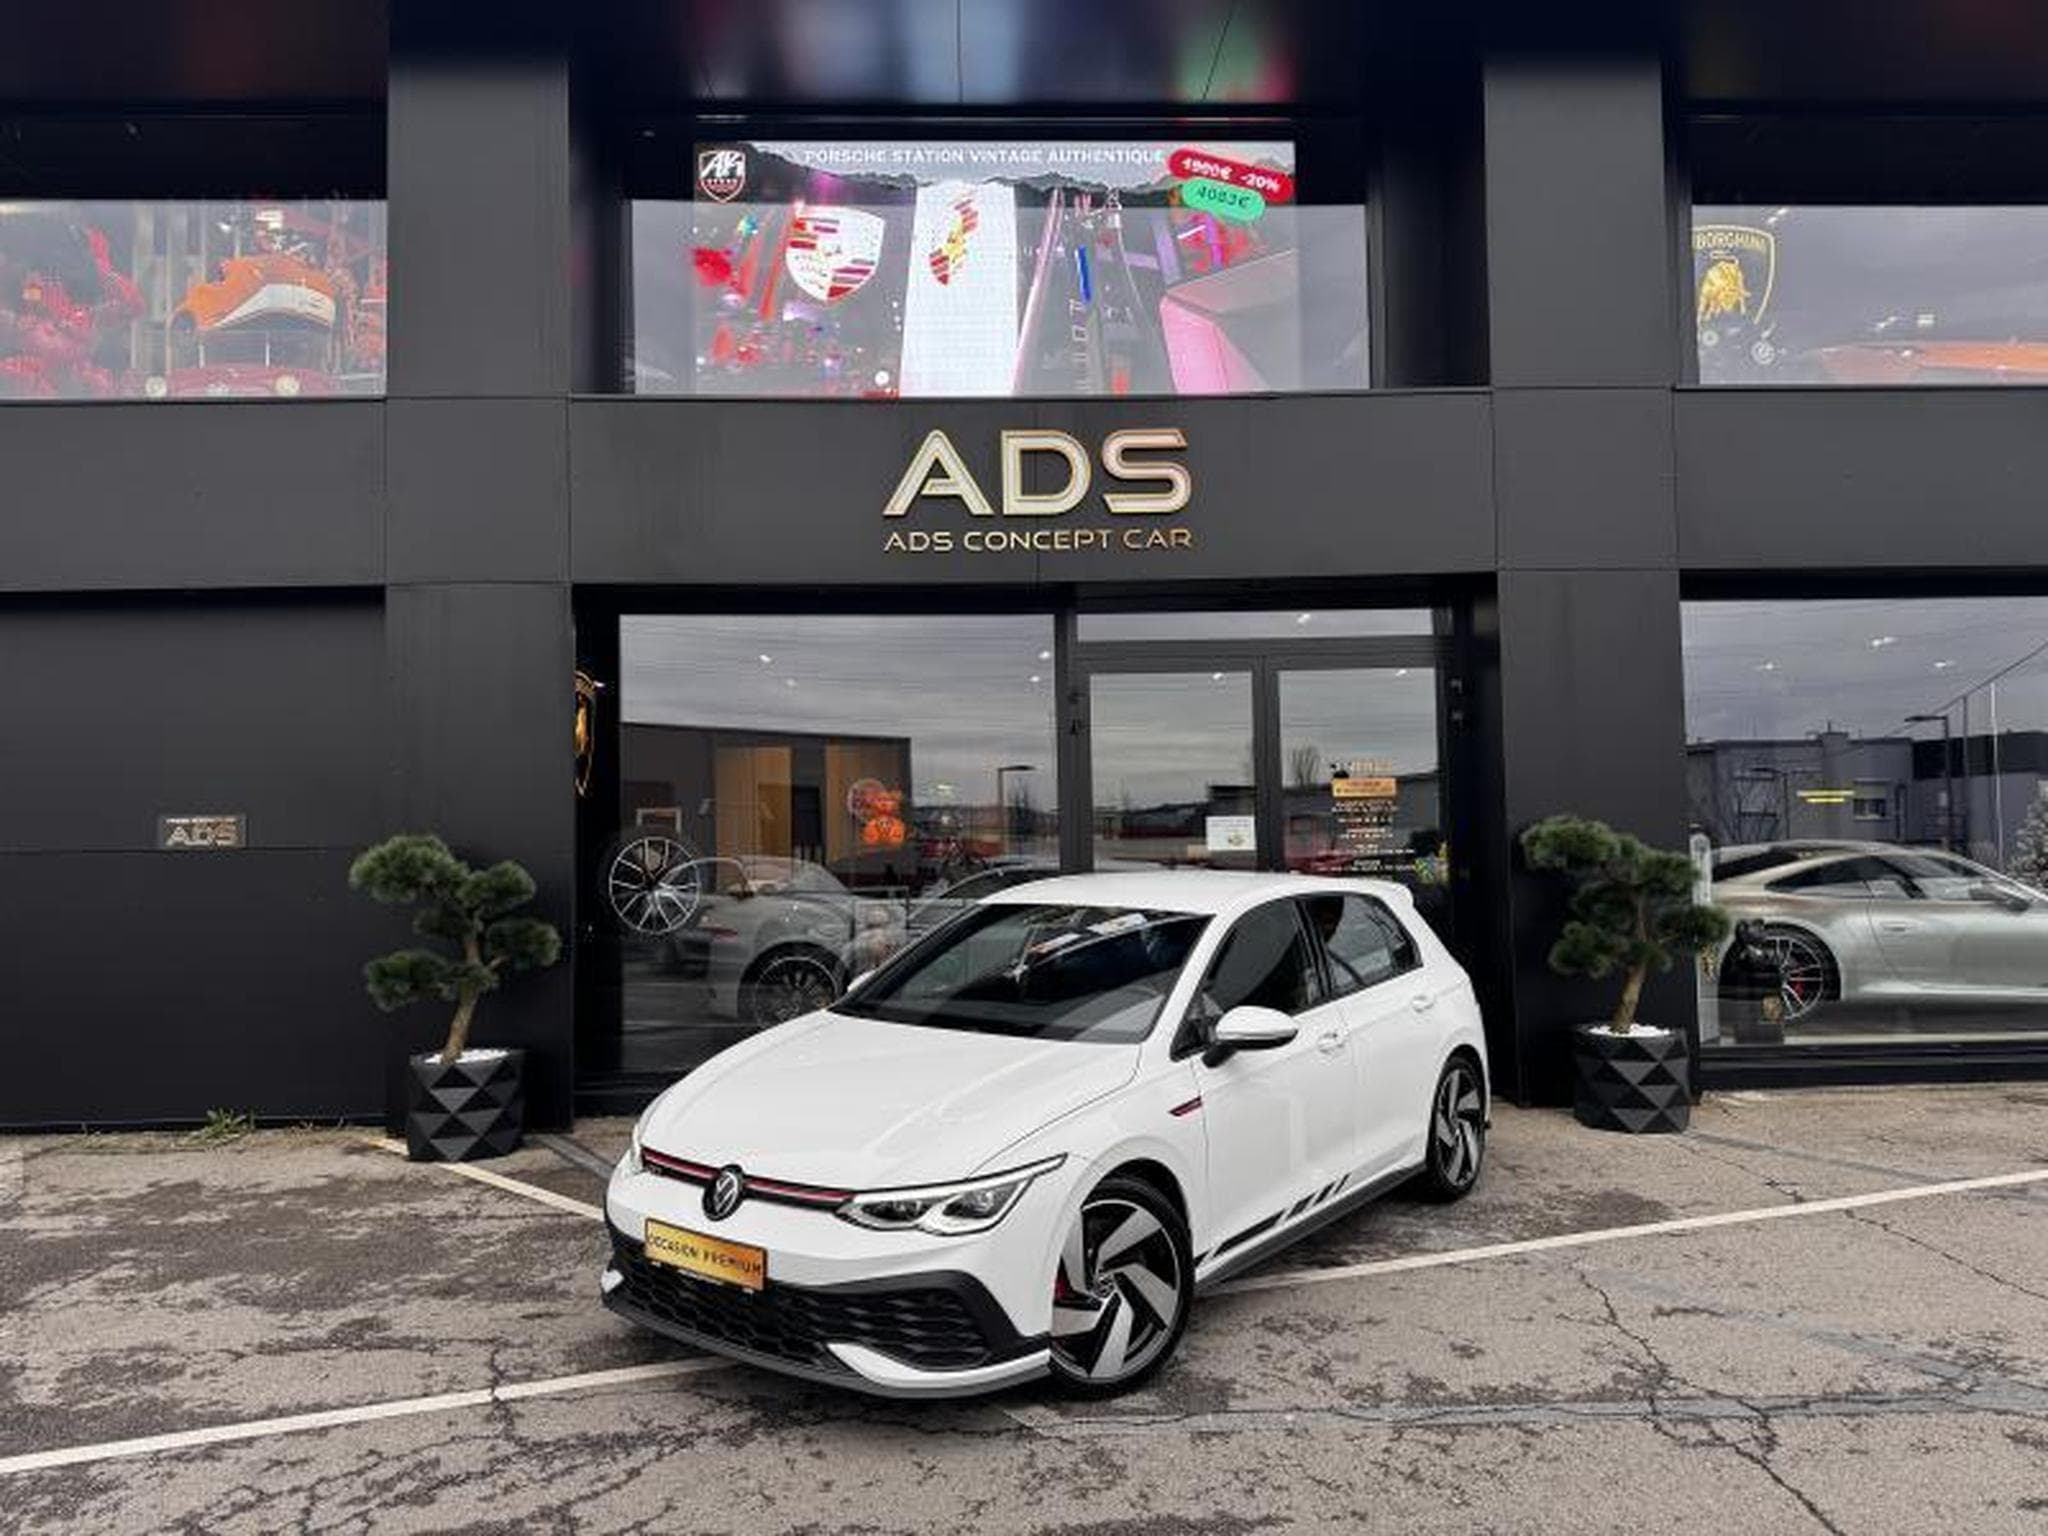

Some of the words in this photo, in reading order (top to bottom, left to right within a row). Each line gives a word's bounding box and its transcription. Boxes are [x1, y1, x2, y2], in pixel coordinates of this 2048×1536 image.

[804, 148, 887, 164] PORSCHE
[891, 148, 964, 164] STATION
[969, 148, 1043, 164] VINTAGE
[1049, 148, 1165, 164] AUTHENTIQUE
[1240, 173, 1280, 193] -20%
[1693, 231, 1767, 252] BORGHINI
[882, 428, 1192, 516] ADS
[884, 531, 953, 551] ADS
[963, 529, 1112, 551] CONCEPT
[1122, 528, 1192, 549] CAR
[166, 825, 239, 846] ADS
[704, 1251, 761, 1273] PREMIUM
